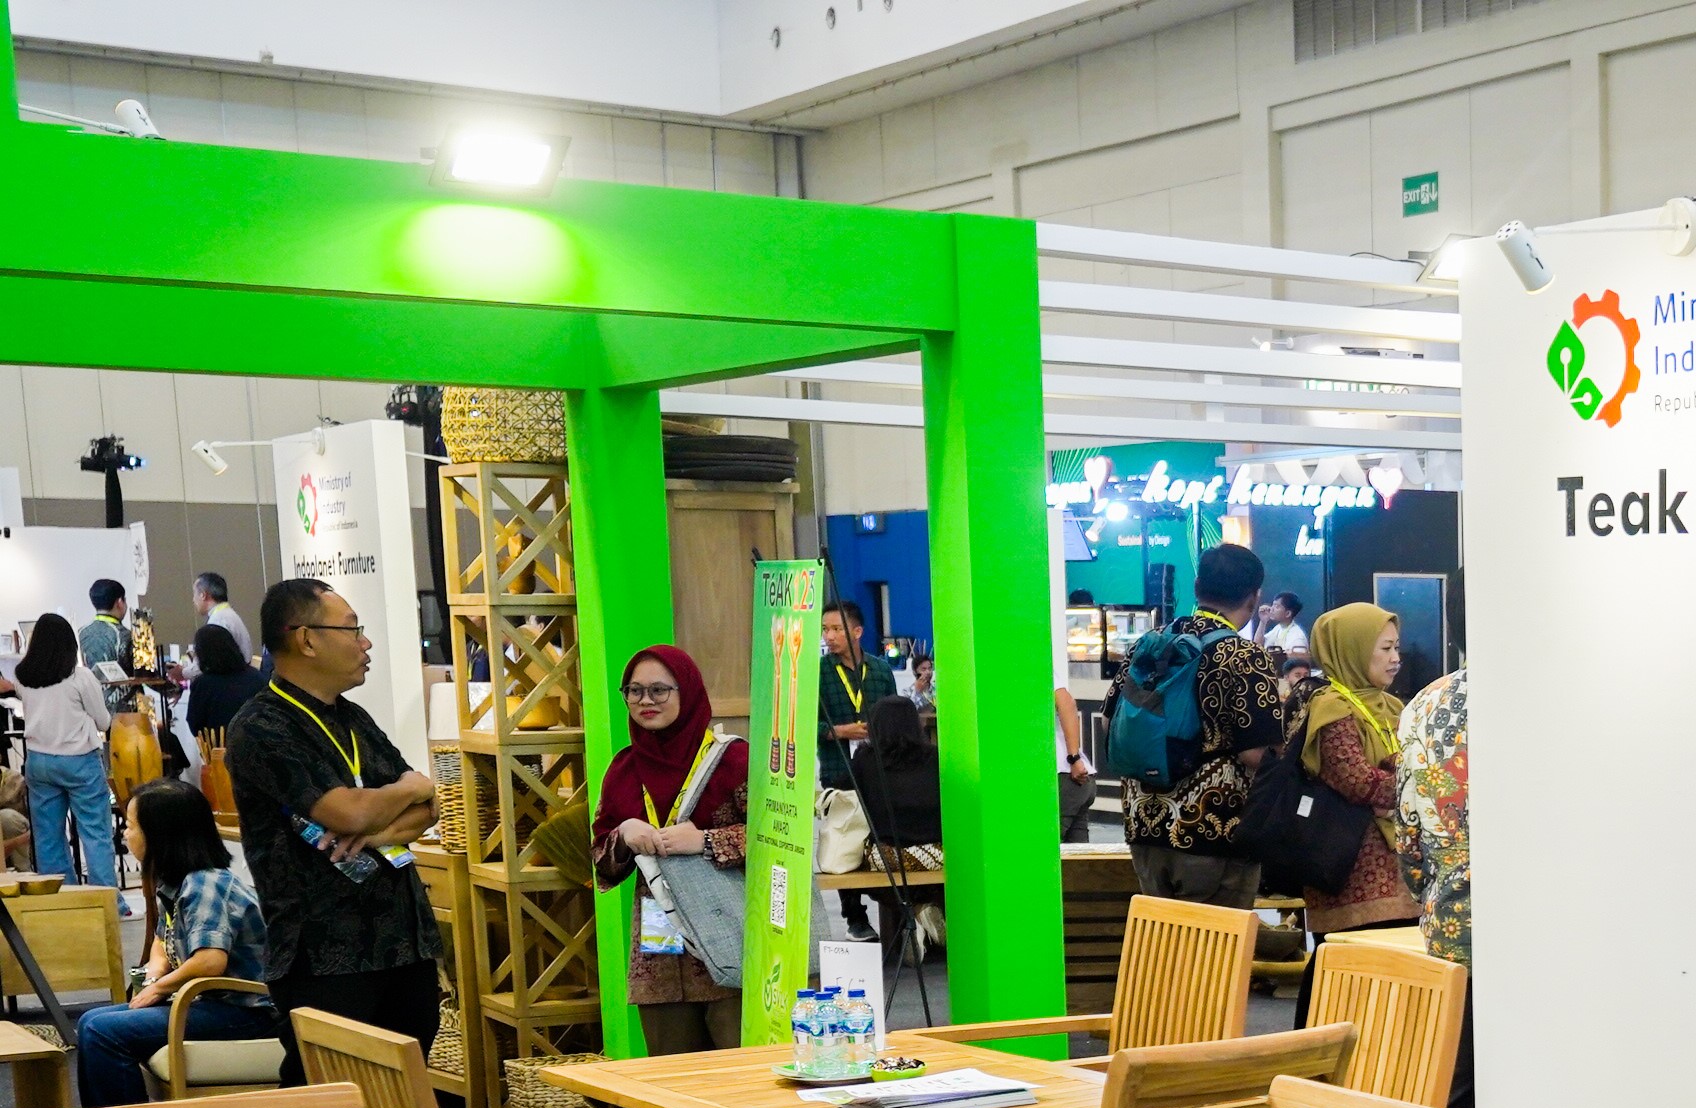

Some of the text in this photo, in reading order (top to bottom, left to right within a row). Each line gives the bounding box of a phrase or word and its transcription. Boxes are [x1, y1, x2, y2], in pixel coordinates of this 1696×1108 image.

[1403, 192, 1421, 205] EXIT
[320, 499, 345, 516] ndustry
[1557, 468, 1688, 537] Teak
[338, 552, 376, 575] Furniture
